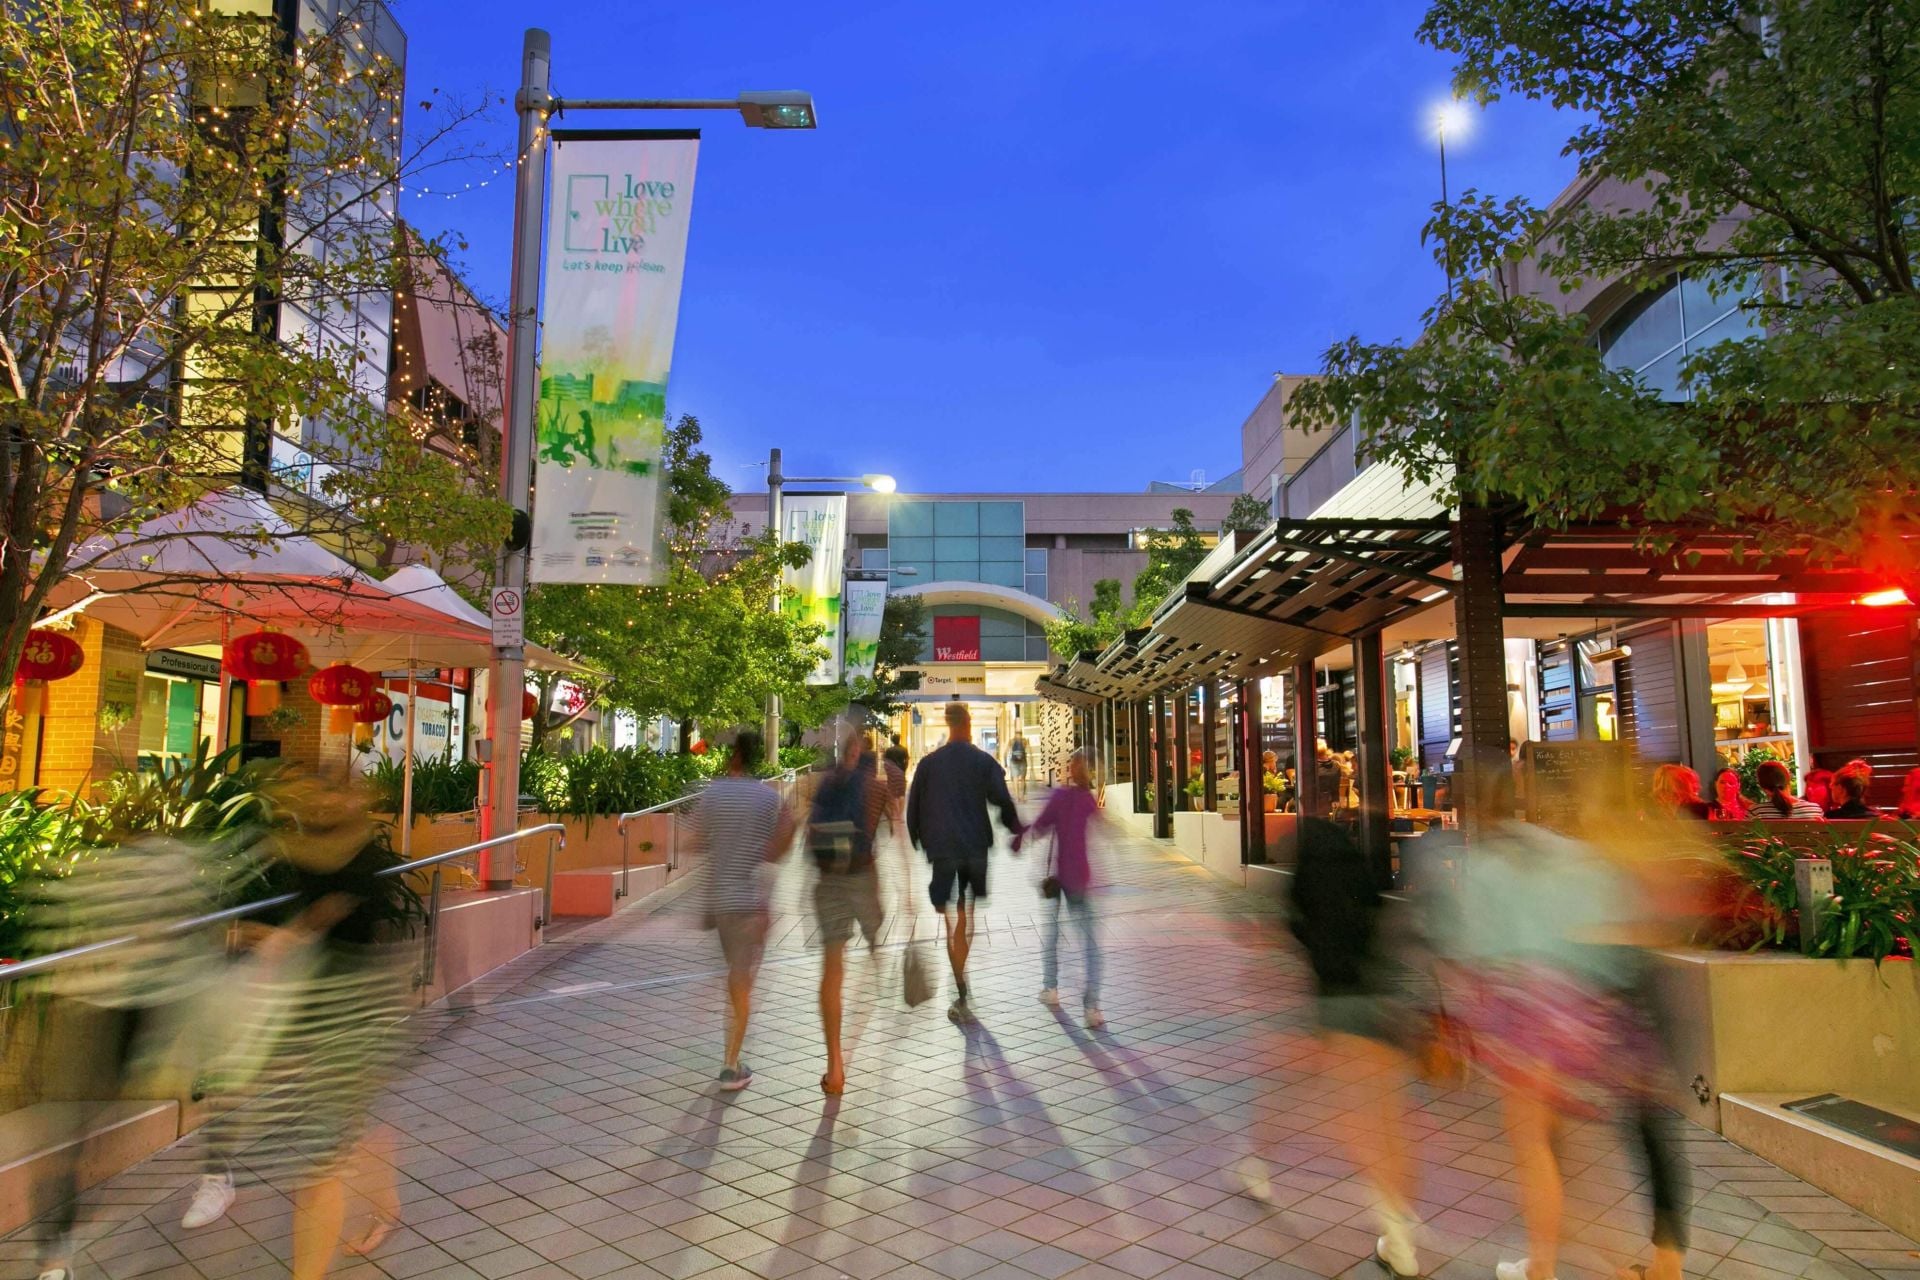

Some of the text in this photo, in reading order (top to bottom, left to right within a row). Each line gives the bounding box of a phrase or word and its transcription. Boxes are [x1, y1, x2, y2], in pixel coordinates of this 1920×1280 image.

[624, 174, 675, 199] love
[602, 227, 645, 254] live
[936, 647, 978, 661] Westfield
[161, 655, 208, 673] Professional
[422, 722, 446, 737] TOBACCO
